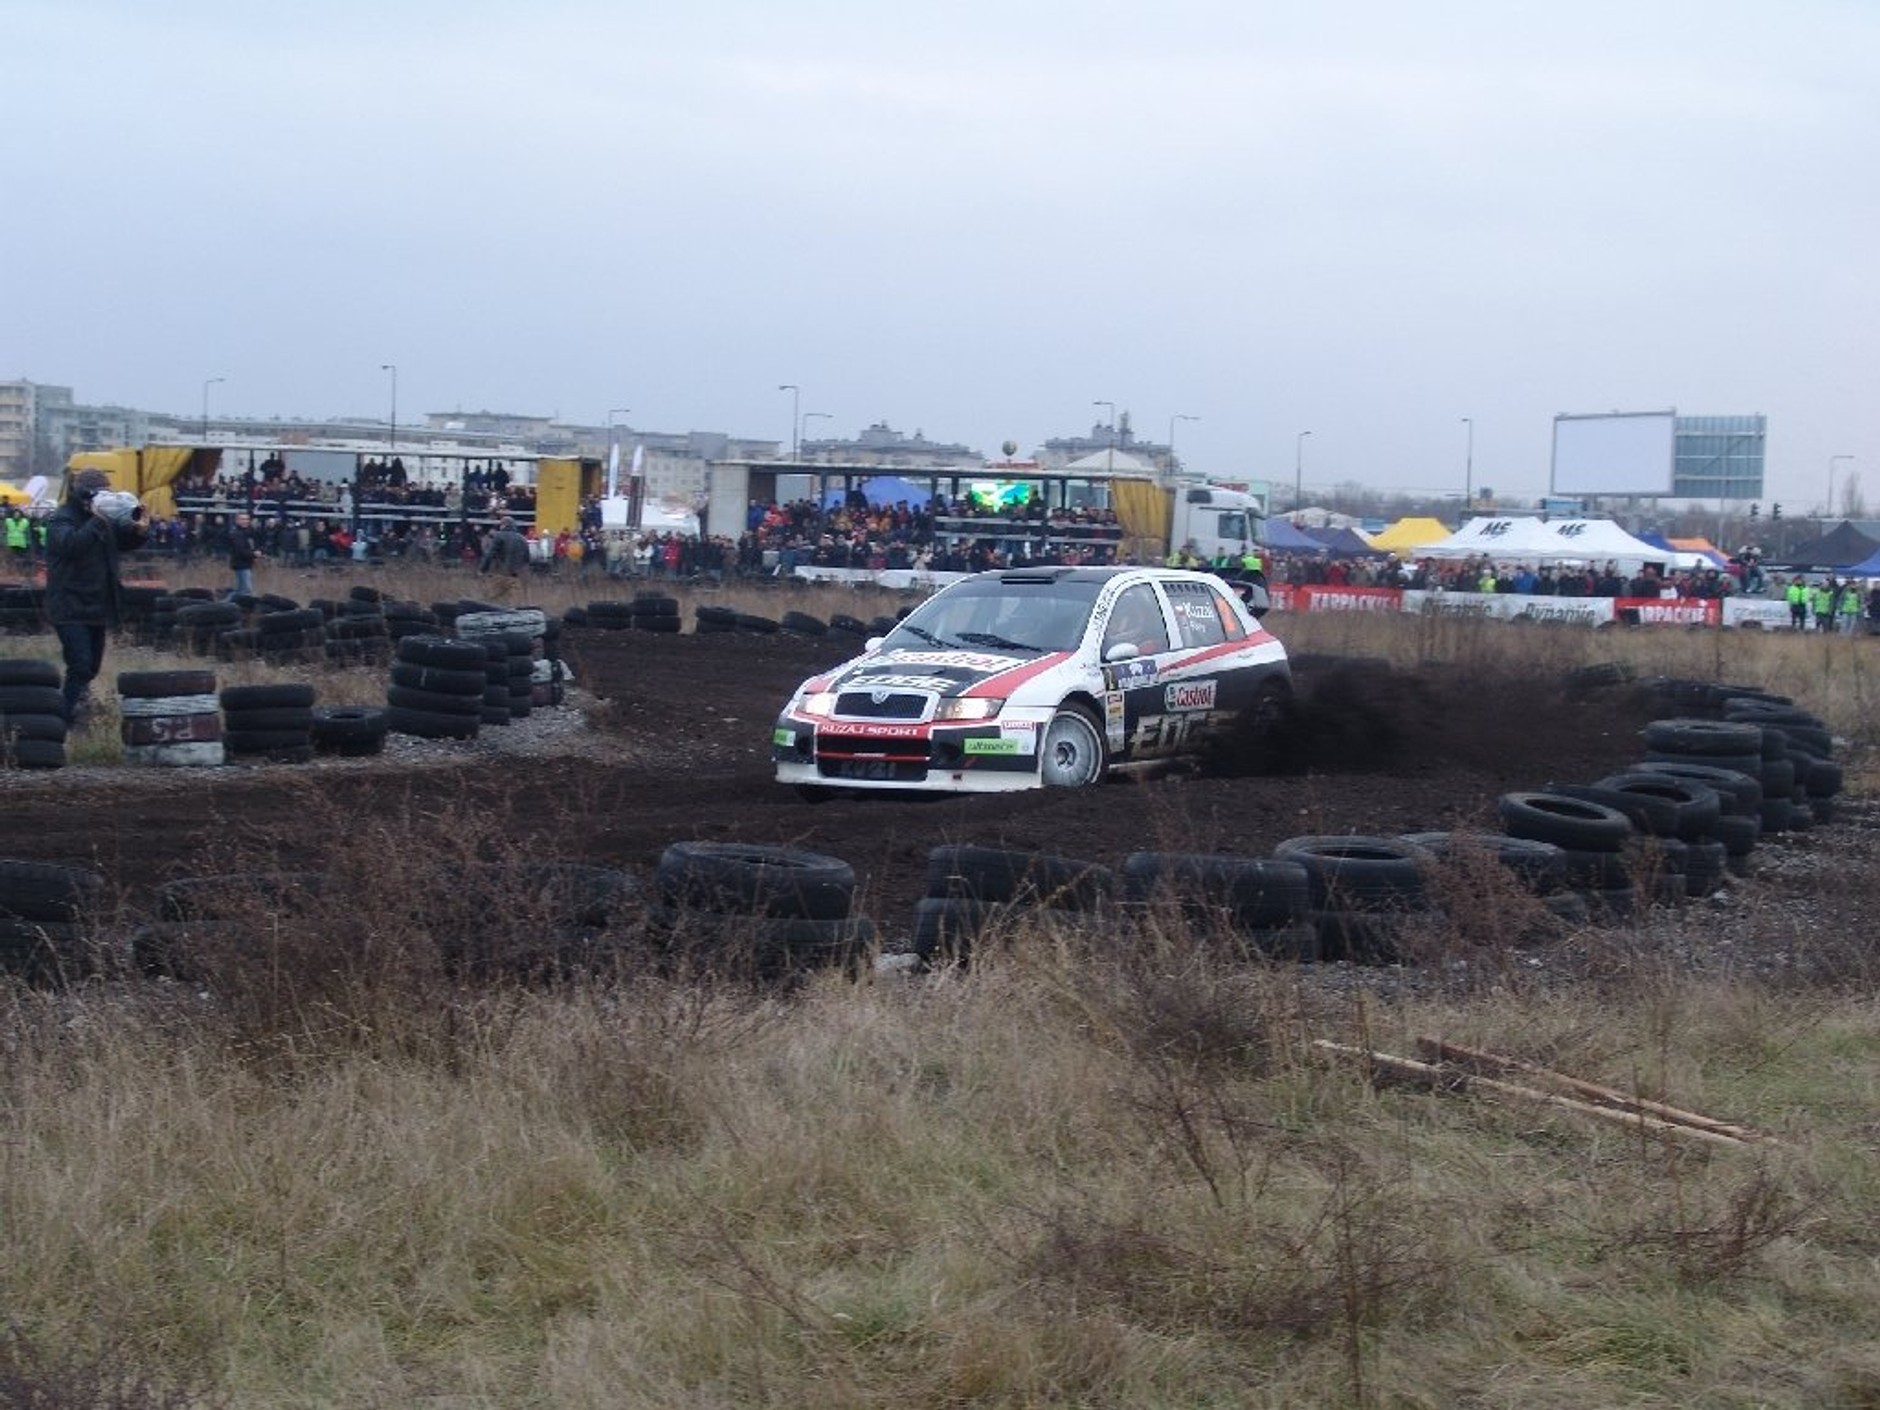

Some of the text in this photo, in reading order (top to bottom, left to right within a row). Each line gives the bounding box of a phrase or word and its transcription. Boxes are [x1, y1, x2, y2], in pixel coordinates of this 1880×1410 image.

[1310, 593, 1391, 612] KARPACKIE
[1525, 602, 1597, 625] Dynamic
[1638, 605, 1706, 624] ARPACKIE
[1176, 686, 1212, 708] Castrol
[867, 724, 919, 738] SPORT
